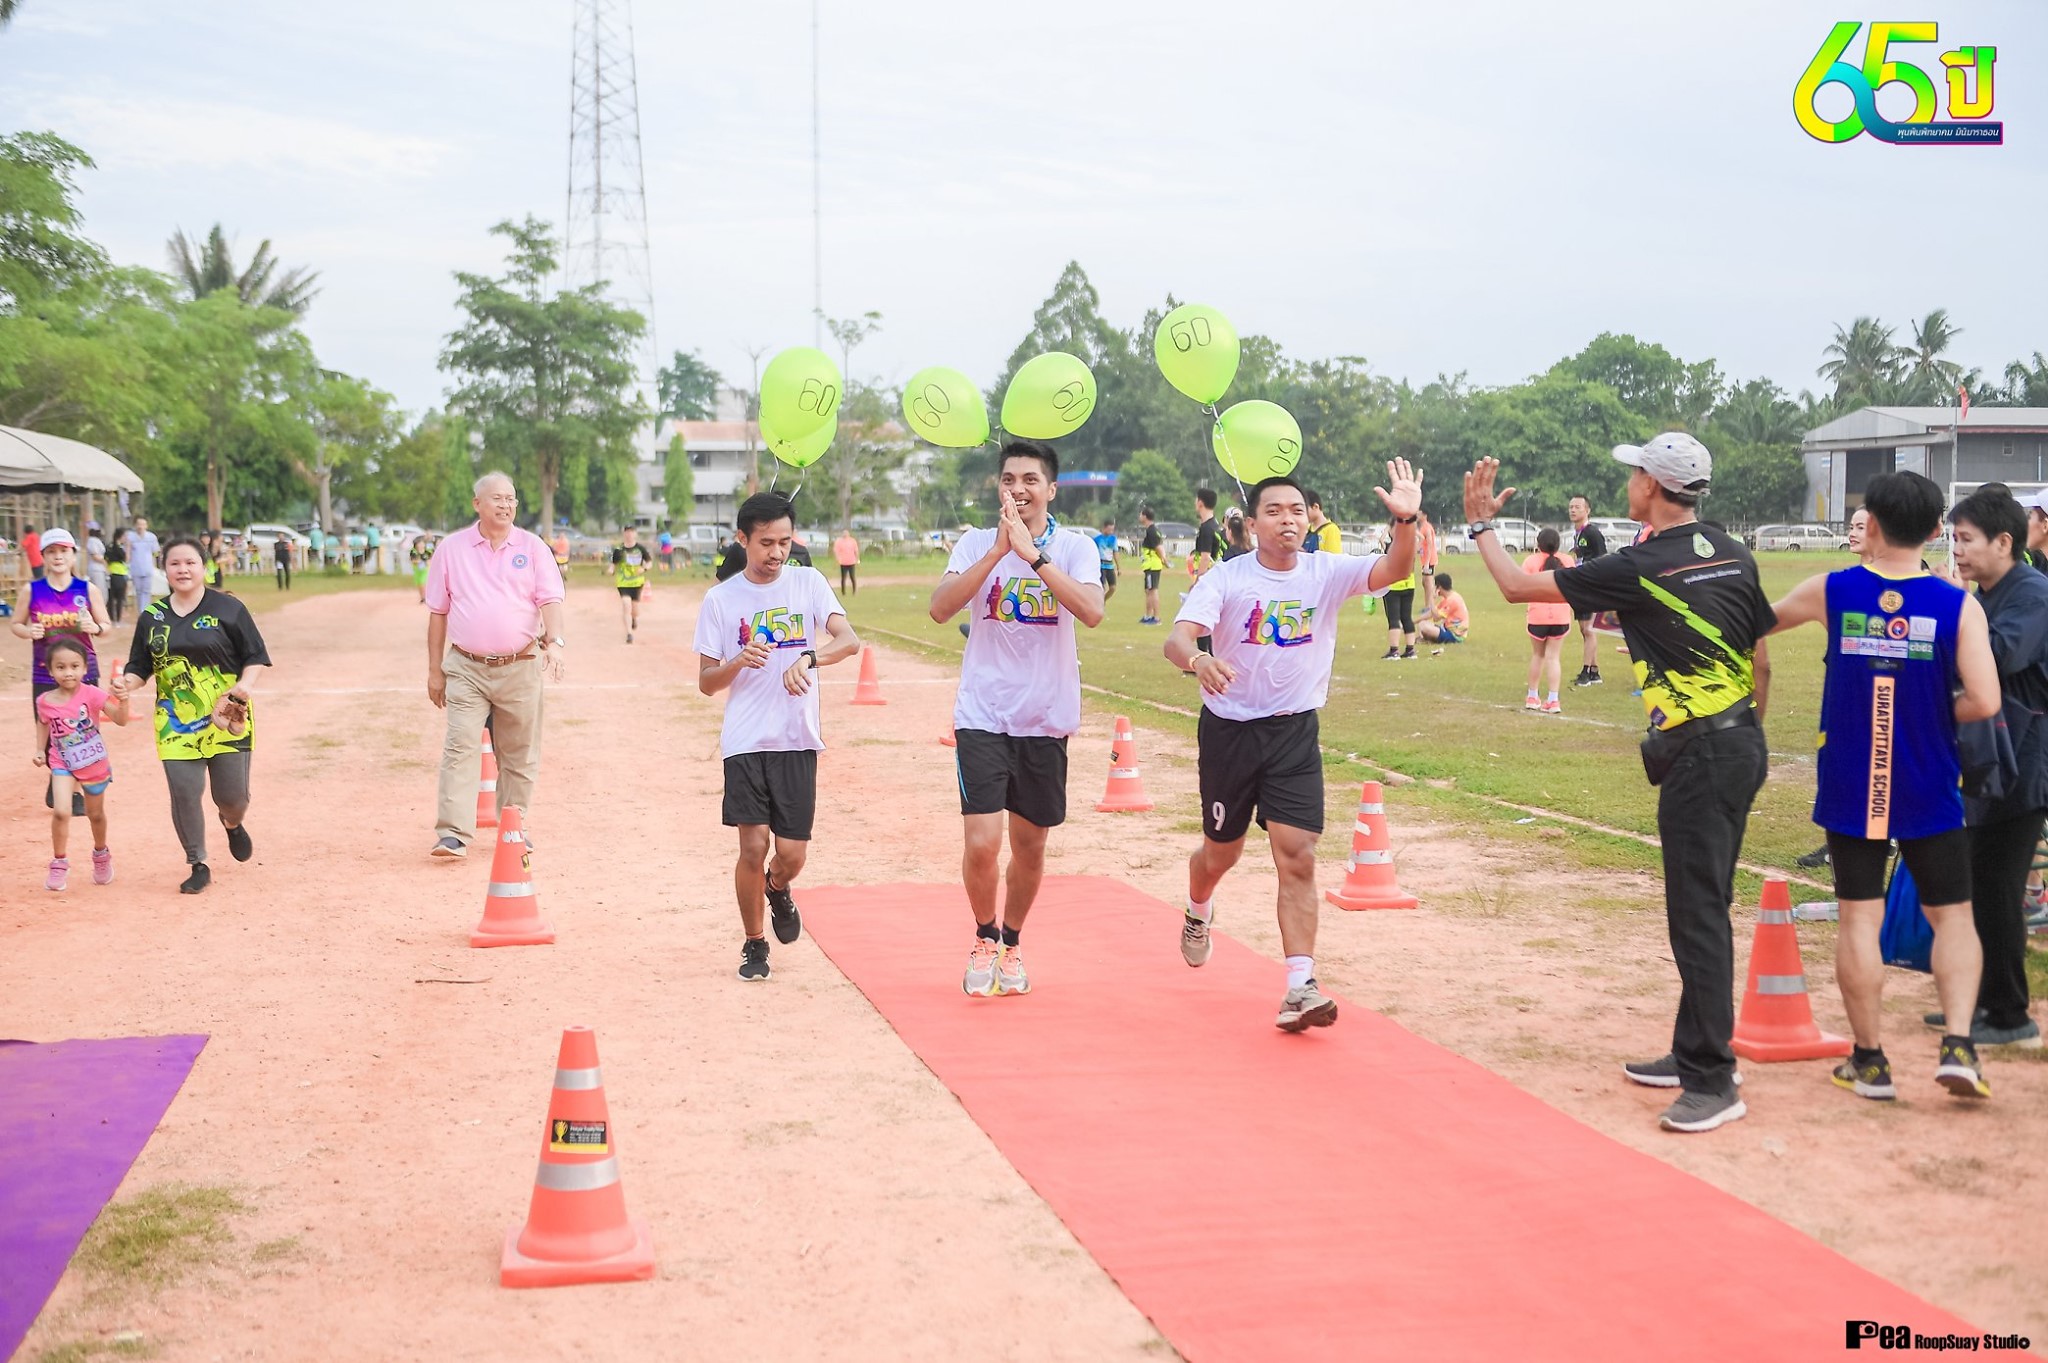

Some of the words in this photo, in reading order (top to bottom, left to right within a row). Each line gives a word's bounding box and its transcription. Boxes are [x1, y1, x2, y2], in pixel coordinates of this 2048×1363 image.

[1170, 317, 1212, 352] 60
[798, 378, 836, 417] 60
[912, 383, 950, 428] 60
[1052, 381, 1091, 422] 60
[1268, 438, 1299, 475] 60
[1875, 686, 1891, 769] SURATPITTAYA
[72, 742, 104, 763] 1238
[1213, 801, 1226, 831] 9
[1871, 774, 1888, 820] SCHOOL
